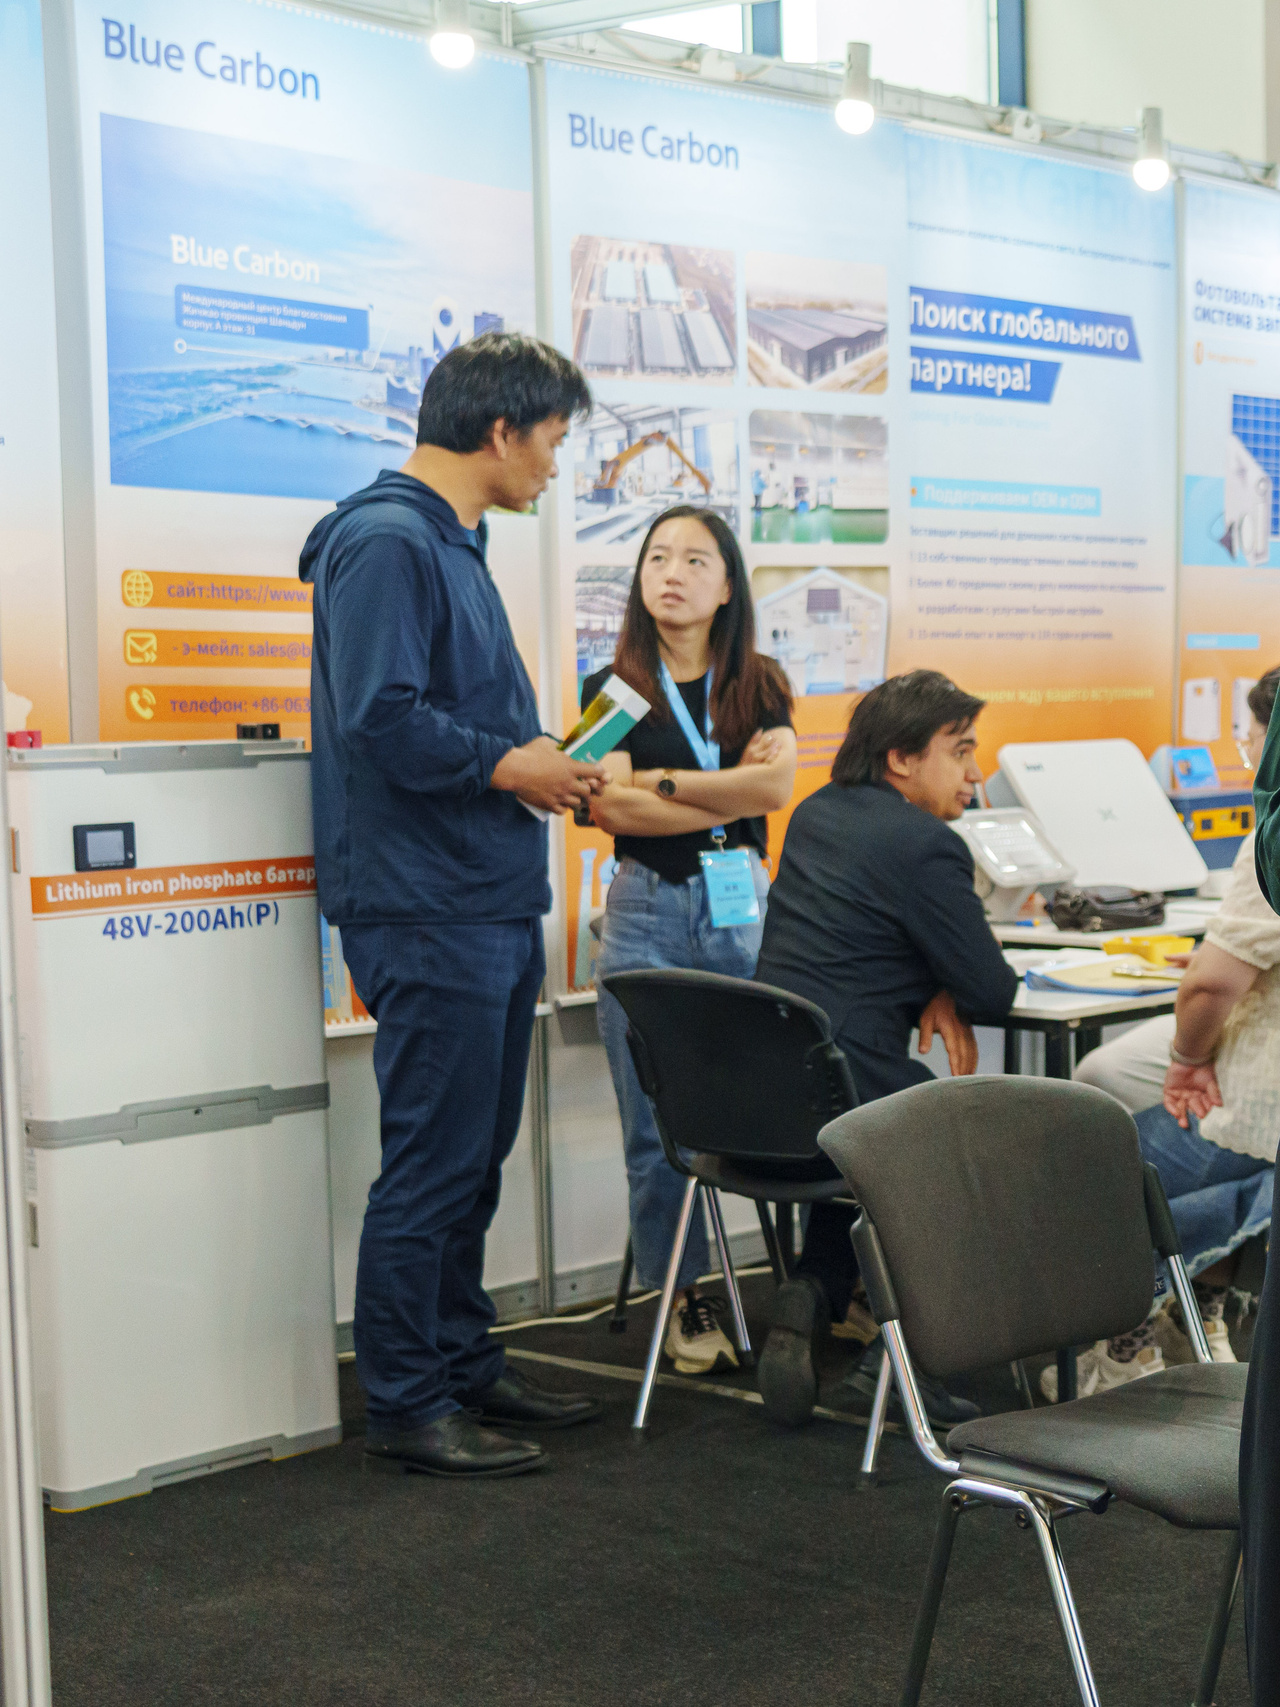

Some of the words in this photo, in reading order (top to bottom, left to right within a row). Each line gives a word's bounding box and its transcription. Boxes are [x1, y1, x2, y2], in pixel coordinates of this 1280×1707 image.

[102, 18, 185, 72] Blue
[194, 41, 319, 101] Carbon
[569, 112, 633, 155] Blue
[641, 125, 739, 170] Carbon
[170, 233, 229, 270] Blue
[233, 245, 319, 283] Carbon
[910, 294, 986, 333] Поиск
[988, 306, 1129, 351] глобального
[1194, 305, 1251, 330] система
[167, 580, 313, 604] сайт:https://www.
[248, 641, 311, 660] sales@b
[169, 697, 247, 716] телефон:
[252, 696, 311, 714] +86-063
[46, 880, 122, 903] Lithium
[126, 876, 164, 895] iron
[168, 867, 262, 898] phosphate
[266, 864, 316, 885] батар
[102, 901, 280, 941] 48V-200Ah(P)
